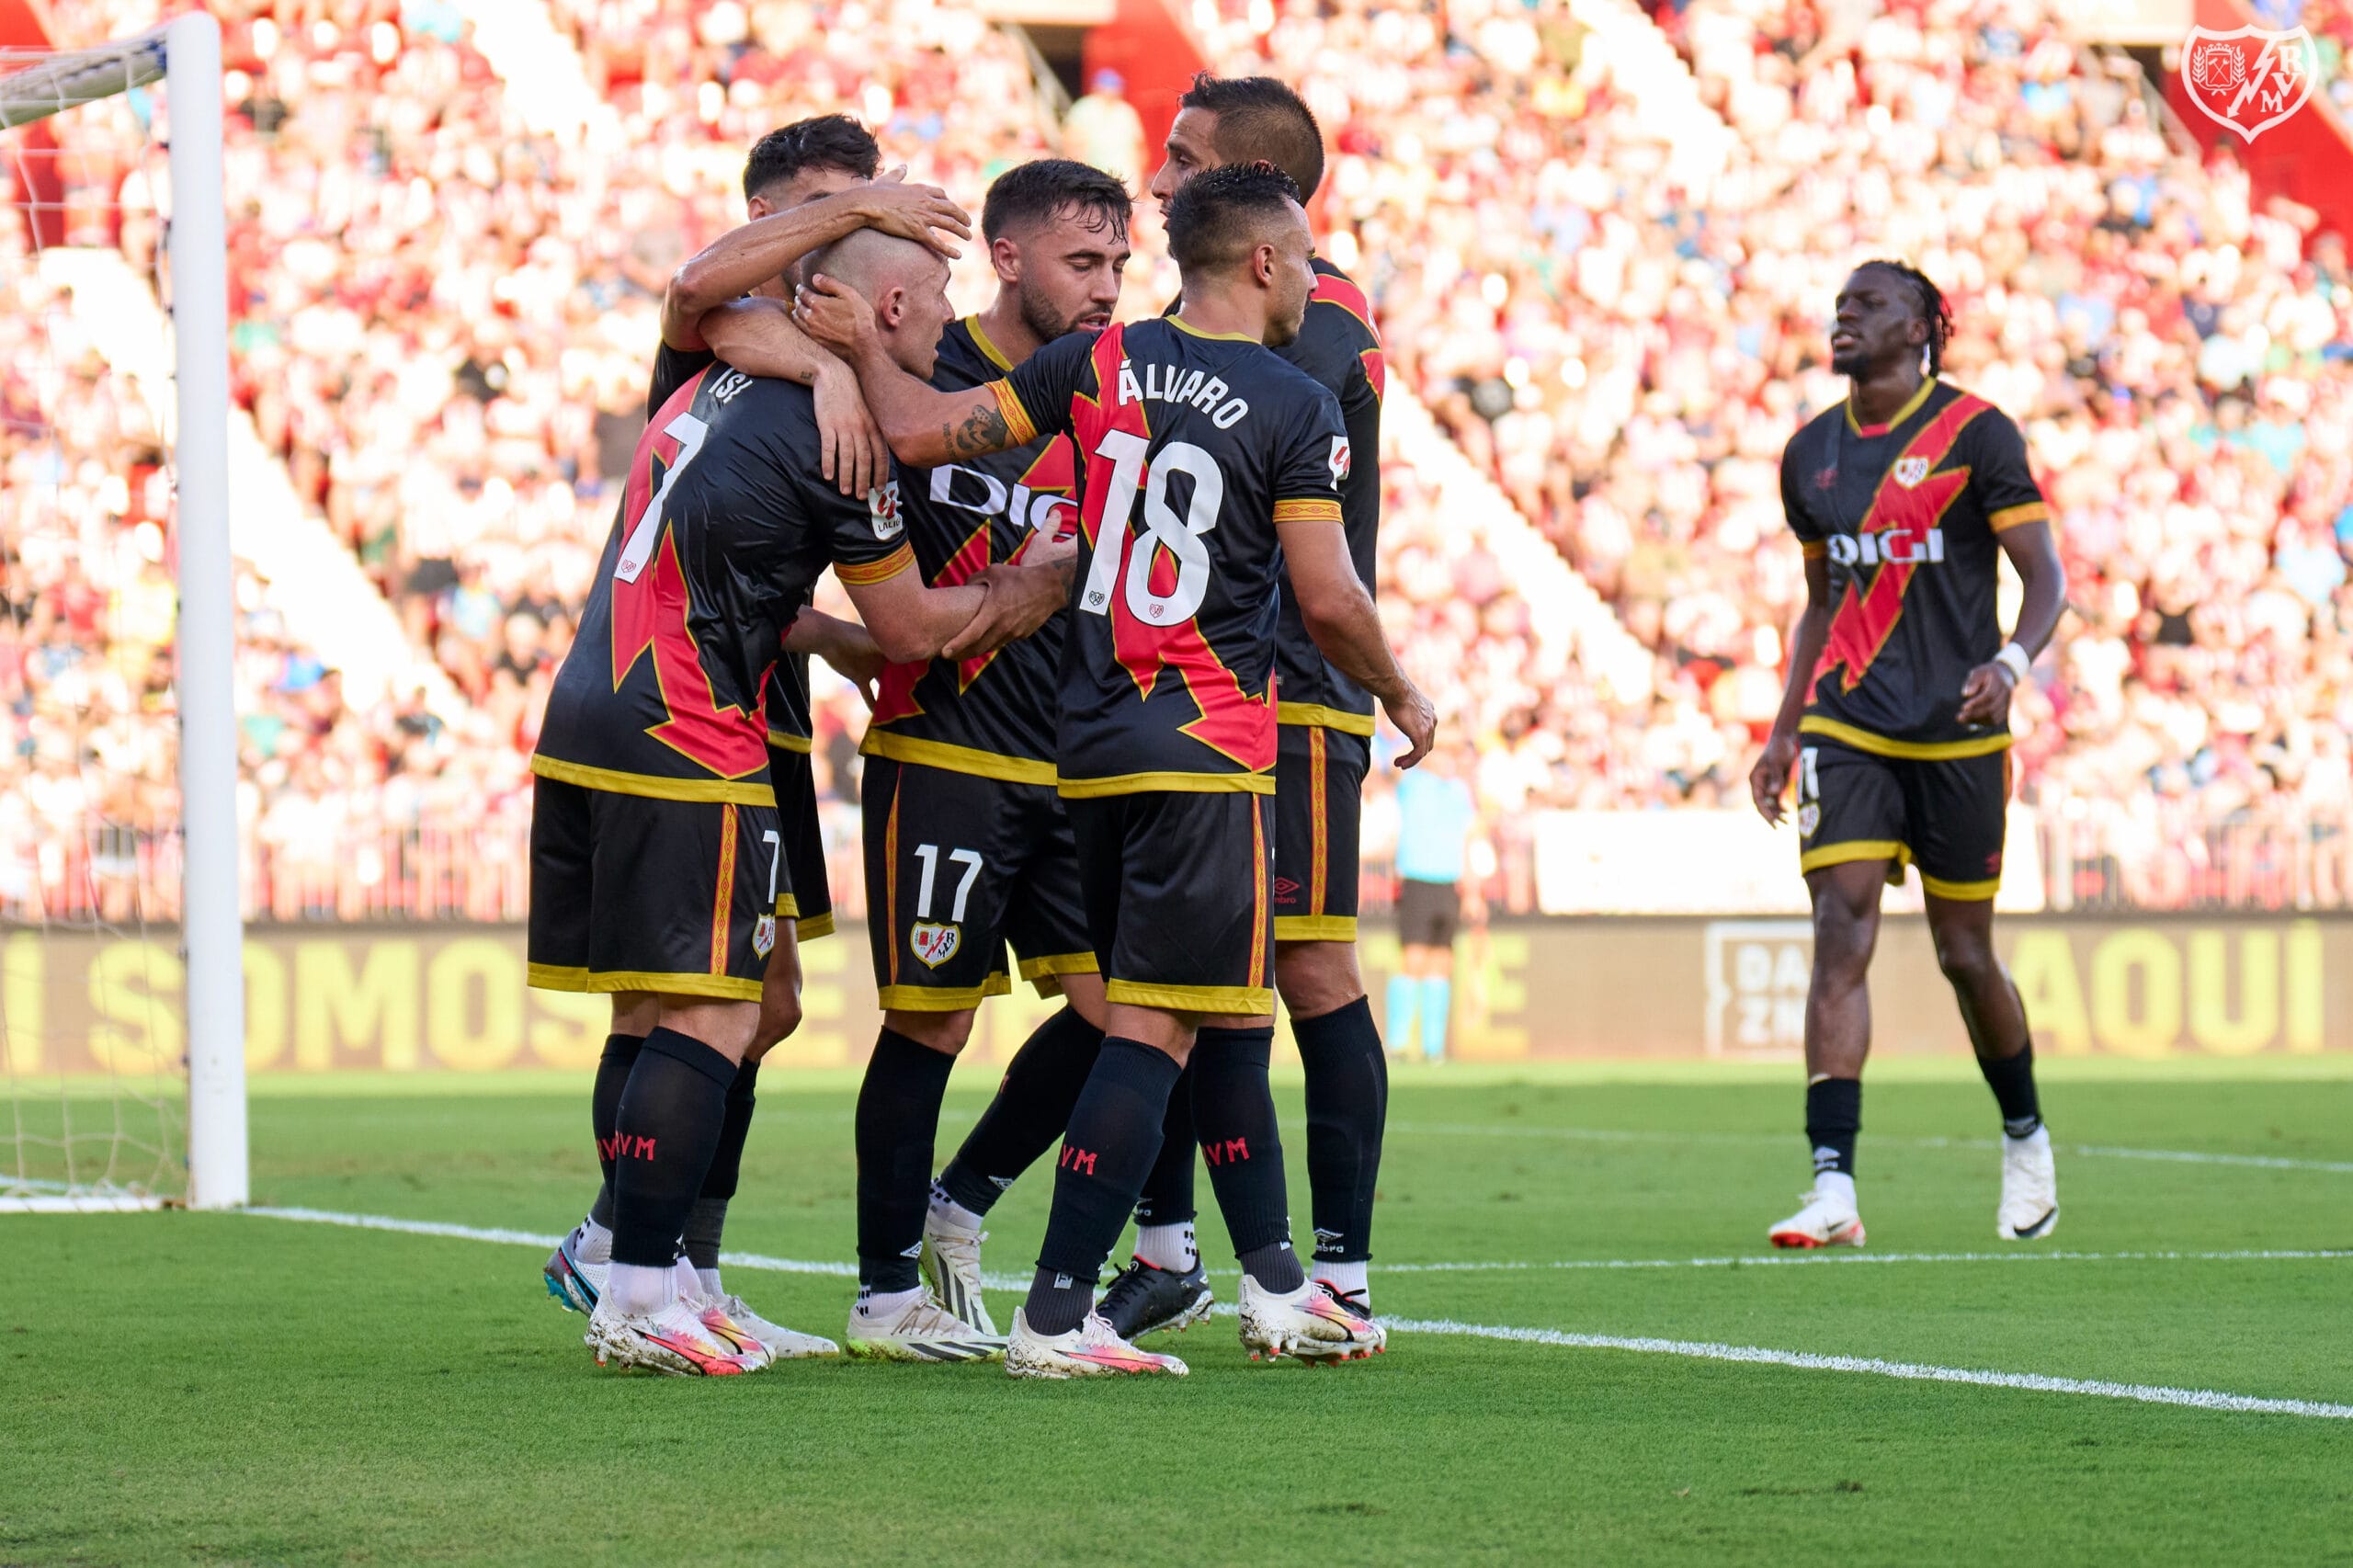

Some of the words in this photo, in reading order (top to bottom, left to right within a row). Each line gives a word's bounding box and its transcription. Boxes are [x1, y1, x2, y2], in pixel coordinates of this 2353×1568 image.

[1117, 359, 1248, 430] ÁLVARO
[613, 412, 709, 584] 7
[878, 517, 903, 532] LALIG
[1079, 428, 1223, 627] 18
[1827, 528, 1945, 566] DIGI
[762, 829, 780, 903] 7
[914, 844, 983, 923] 17
[616, 1131, 656, 1161] VM
[1202, 1136, 1250, 1167] VM
